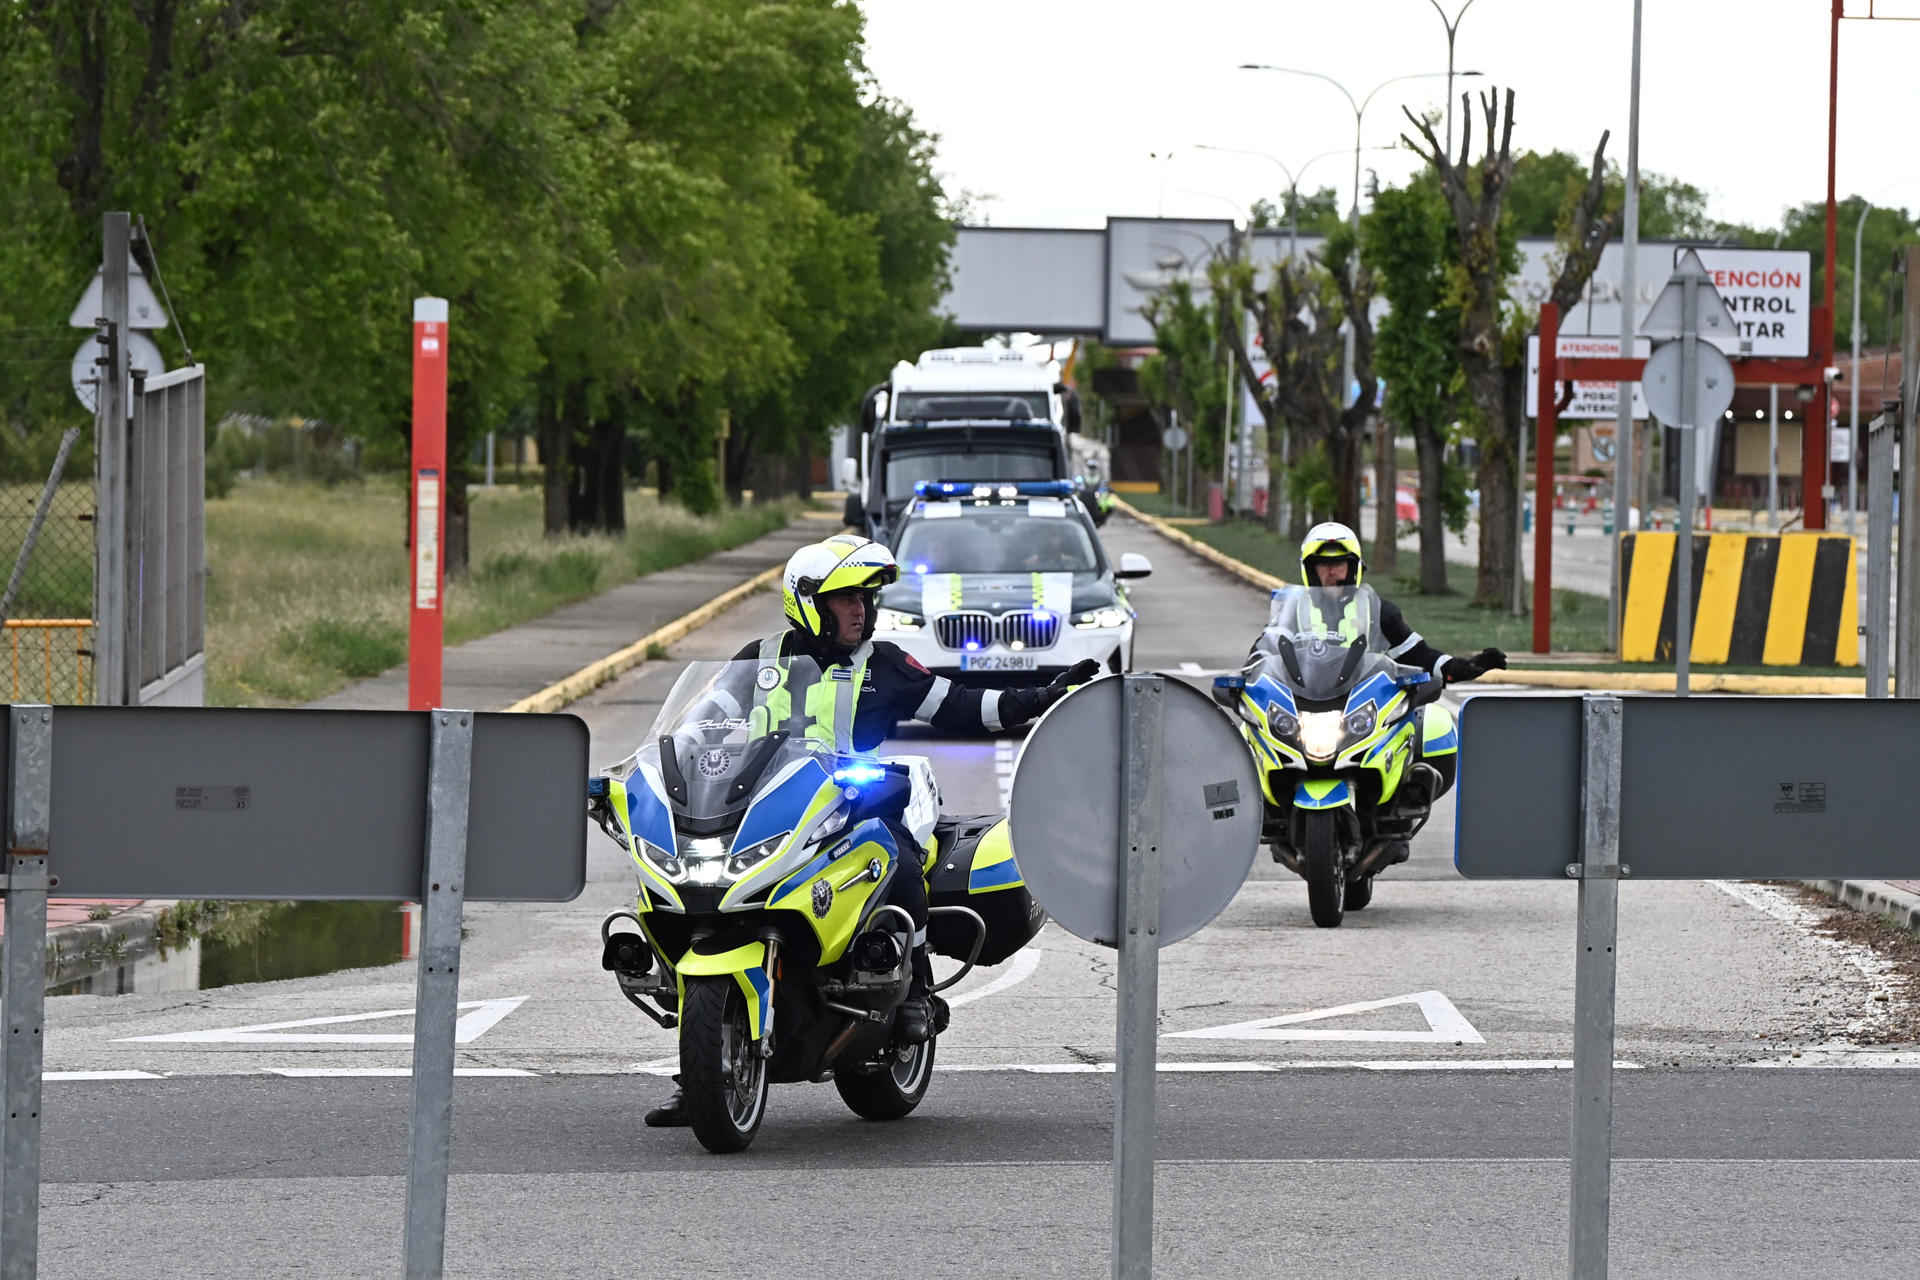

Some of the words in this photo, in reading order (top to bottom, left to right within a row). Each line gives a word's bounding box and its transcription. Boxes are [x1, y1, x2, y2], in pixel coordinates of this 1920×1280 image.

[1707, 268, 1802, 288] ENCIÓN
[1722, 296, 1796, 314] NTROL
[1737, 321, 1785, 338] ITAR
